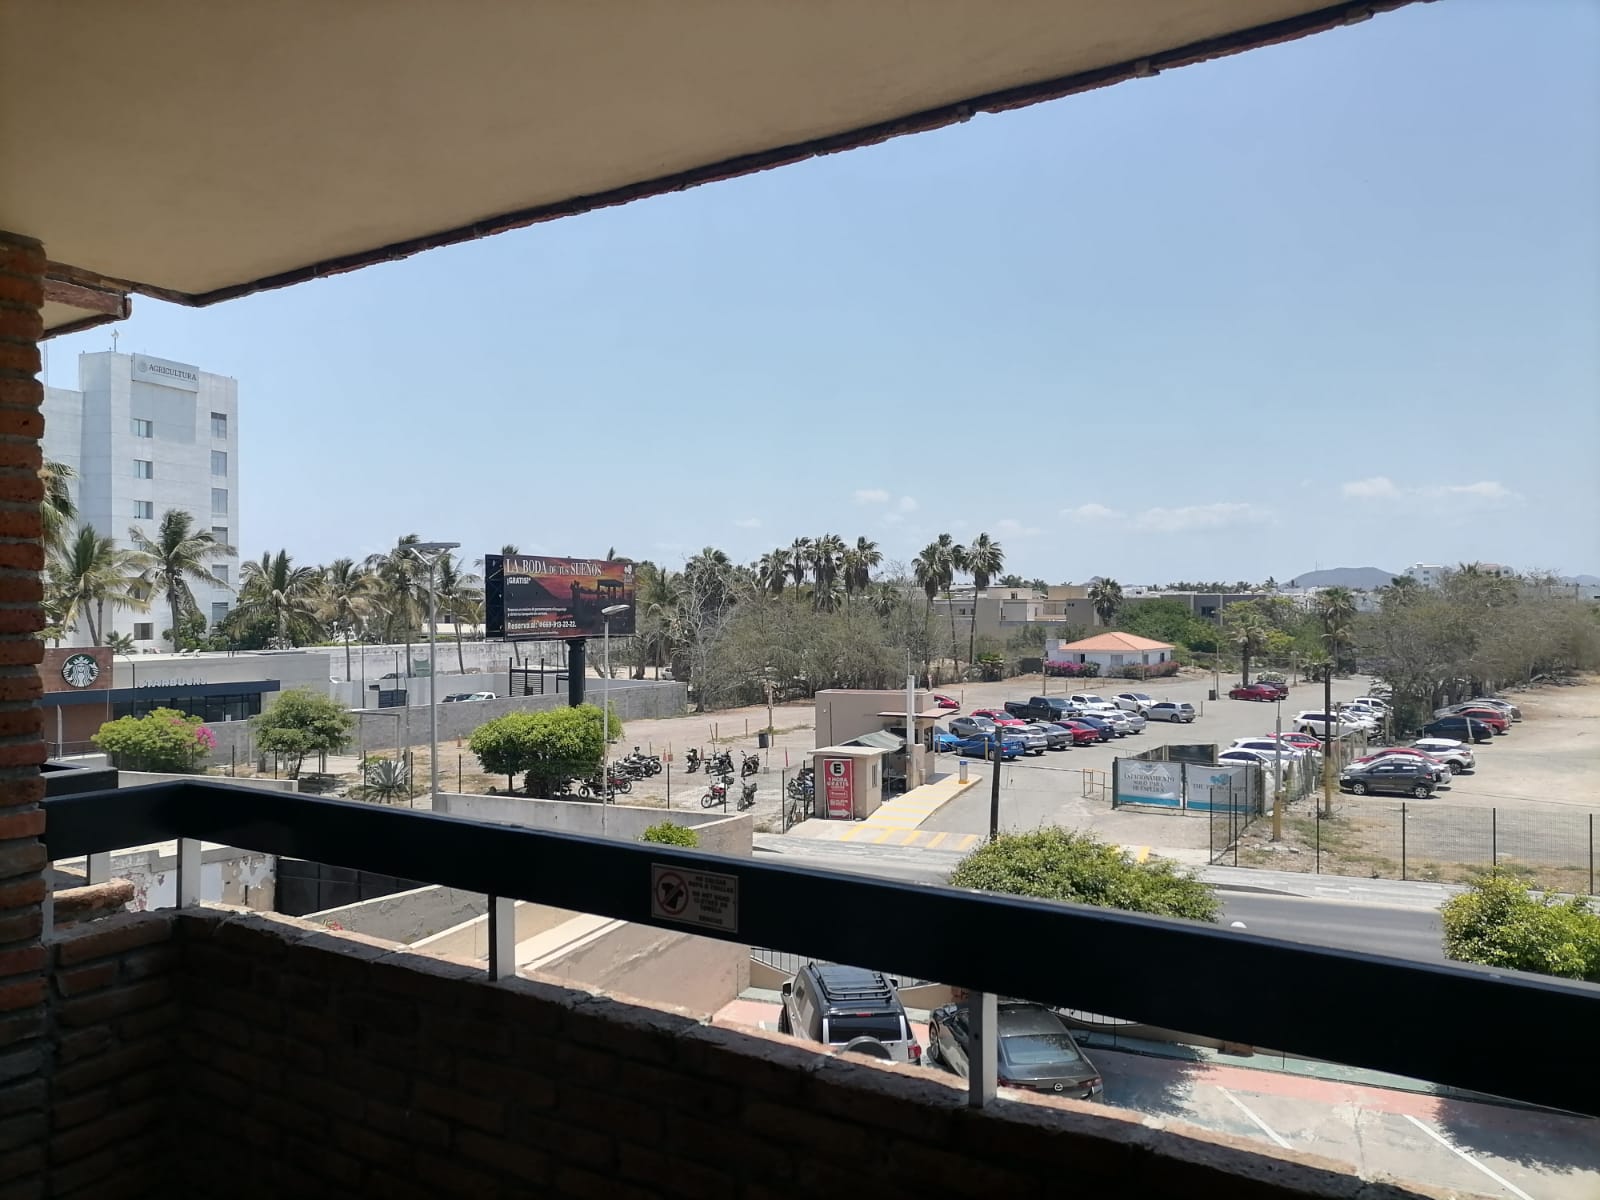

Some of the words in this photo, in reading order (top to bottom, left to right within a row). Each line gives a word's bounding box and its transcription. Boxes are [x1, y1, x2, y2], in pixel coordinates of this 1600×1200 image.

[149, 364, 196, 381] AGRICULTURA
[506, 559, 519, 573] LA
[522, 560, 547, 574] BODA
[570, 560, 602, 576] SUEÑOS
[833, 764, 841, 774] E
